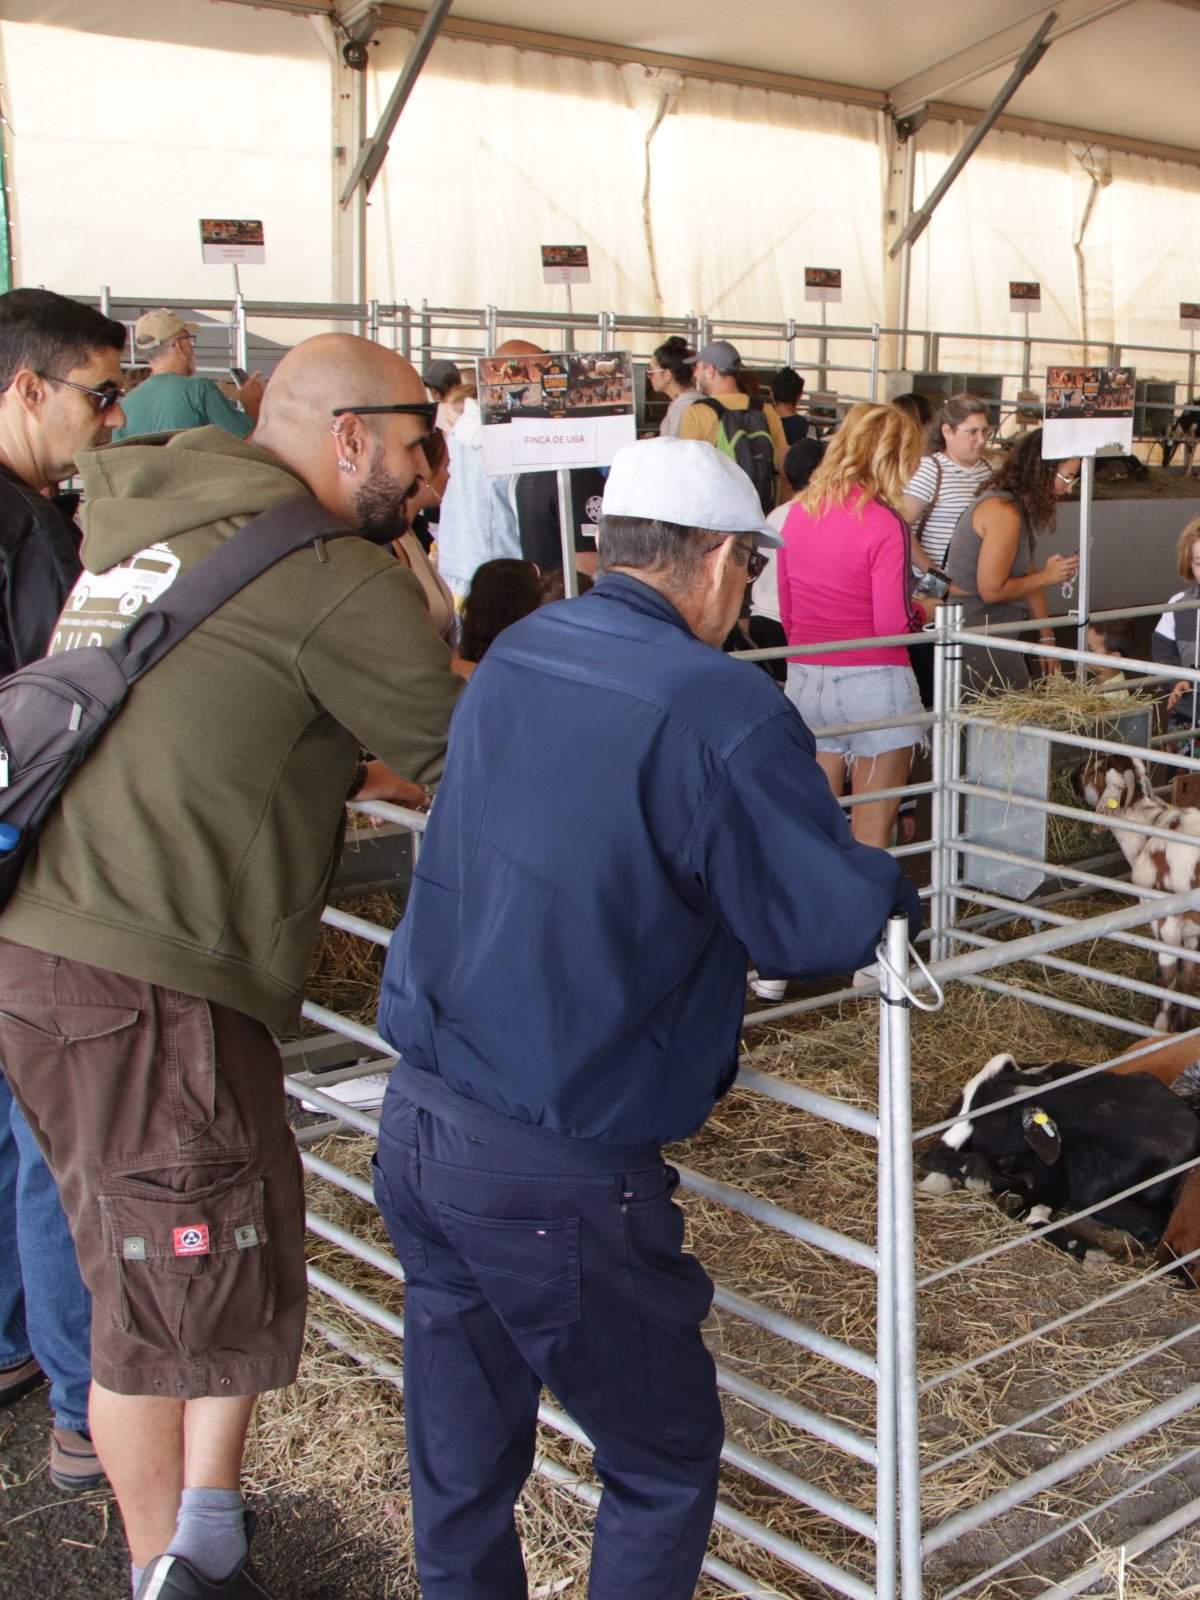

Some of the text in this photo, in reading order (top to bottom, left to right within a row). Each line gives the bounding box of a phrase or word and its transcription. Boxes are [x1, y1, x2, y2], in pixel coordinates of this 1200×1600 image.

[524, 434, 585, 445] FINCA DE UGA
